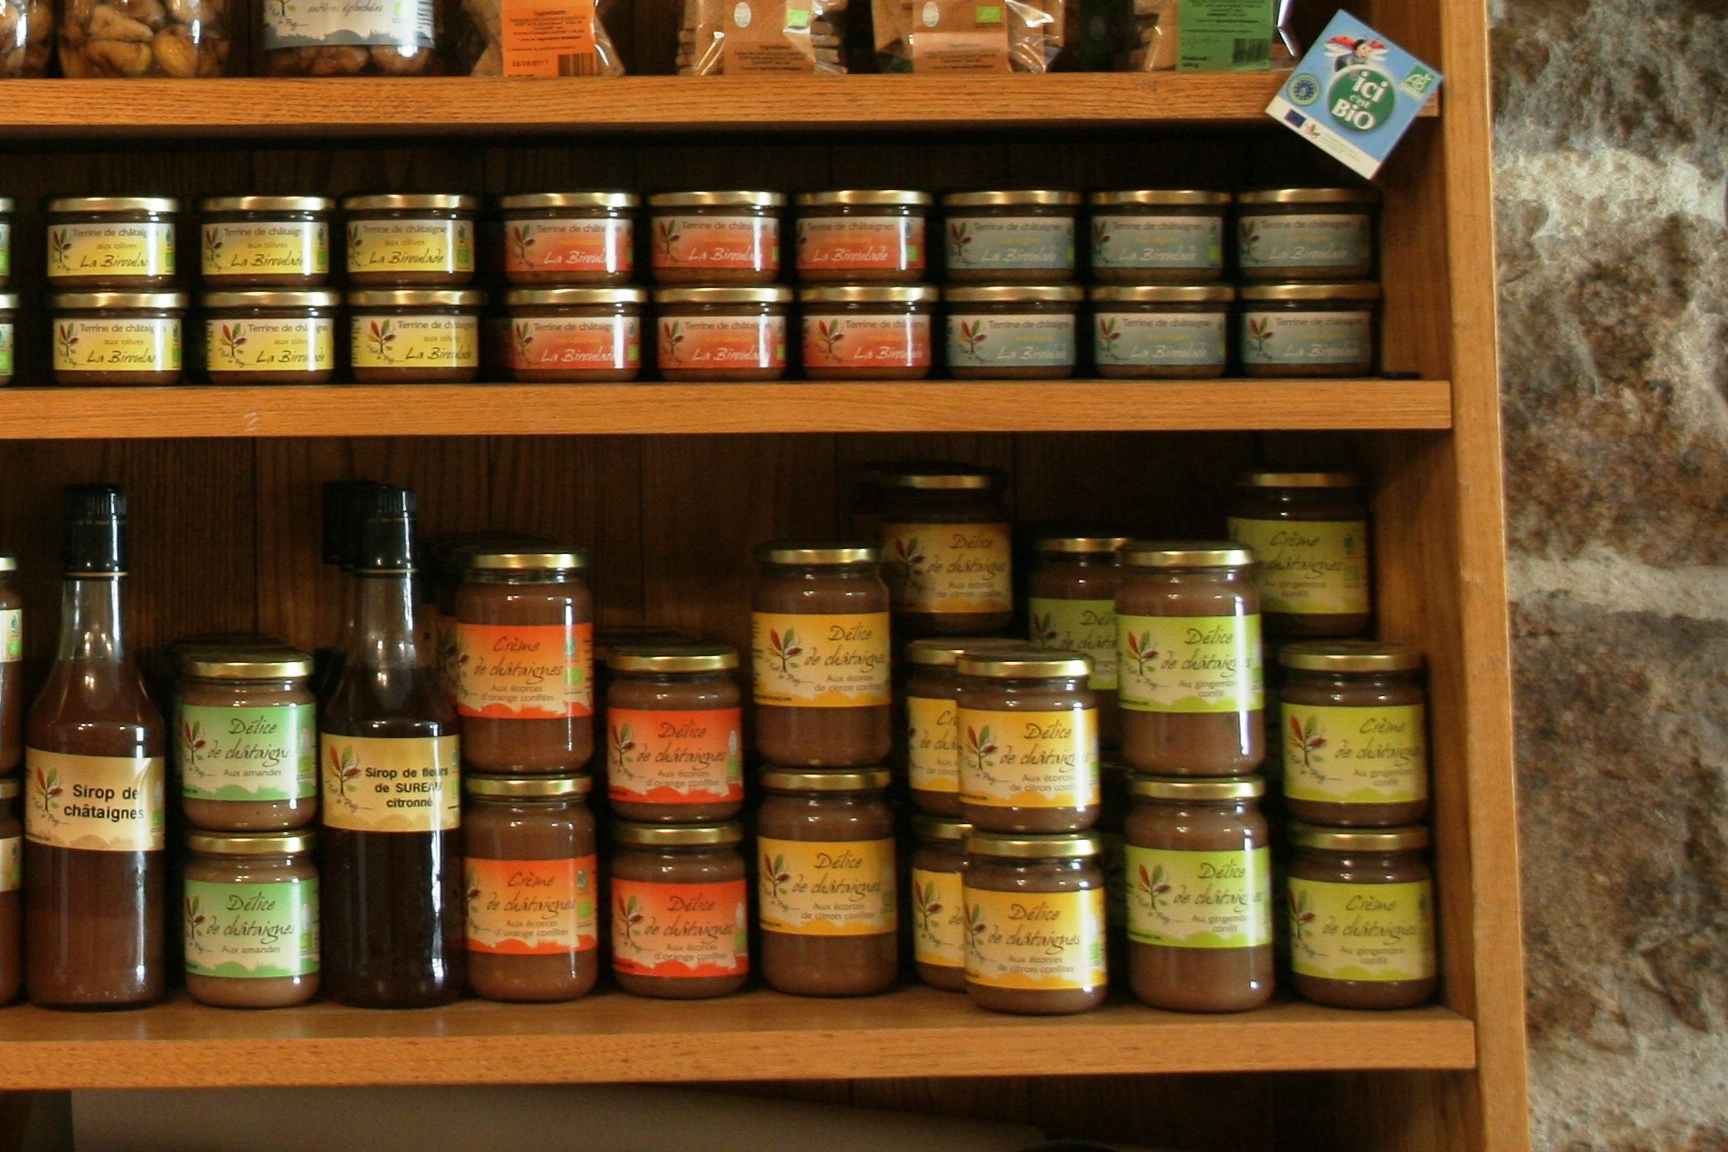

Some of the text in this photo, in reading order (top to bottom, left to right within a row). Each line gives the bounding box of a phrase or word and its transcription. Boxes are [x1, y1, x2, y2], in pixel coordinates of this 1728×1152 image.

[1352, 70, 1390, 103] ici
[1406, 73, 1432, 92] AB
[1349, 94, 1370, 109] c'est
[388, 249, 444, 264] Biroulade
[831, 245, 888, 262] Biroulade
[489, 656, 562, 685] châtaignes
[509, 684, 542, 693] écorces
[481, 692, 554, 704] d'orange confites
[243, 768, 282, 777] amandes
[365, 767, 397, 780] Sirop
[73, 784, 114, 802] Sirop
[386, 796, 433, 809] citronné
[495, 928, 532, 938] d'orange
[240, 946, 281, 954] amandes
